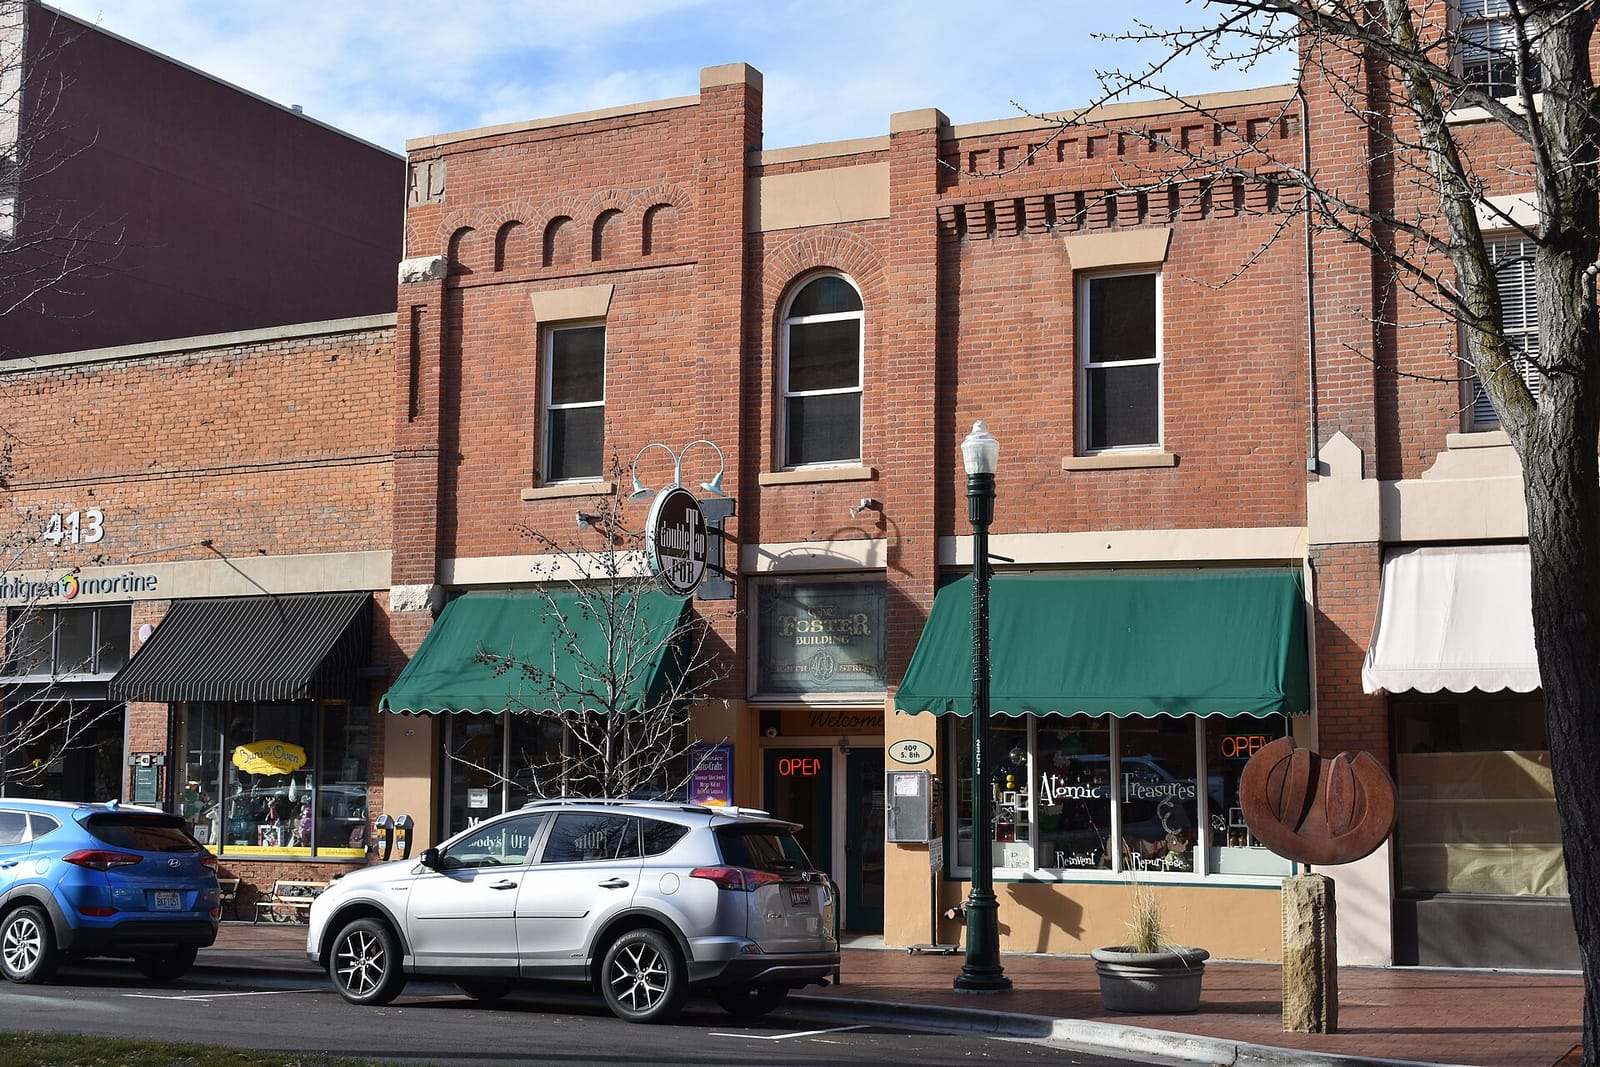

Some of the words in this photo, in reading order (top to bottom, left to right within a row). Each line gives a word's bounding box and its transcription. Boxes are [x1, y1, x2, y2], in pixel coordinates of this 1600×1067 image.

[42, 509, 105, 546] 413
[671, 558, 694, 583] PUB
[0, 575, 60, 603] hlgren
[82, 572, 158, 594] mortine
[779, 612, 872, 637] FOSTER
[796, 635, 850, 646] BUILDING
[903, 744, 918, 752] 409
[1039, 771, 1101, 807] Atomic
[1121, 772, 1196, 804] Treasures
